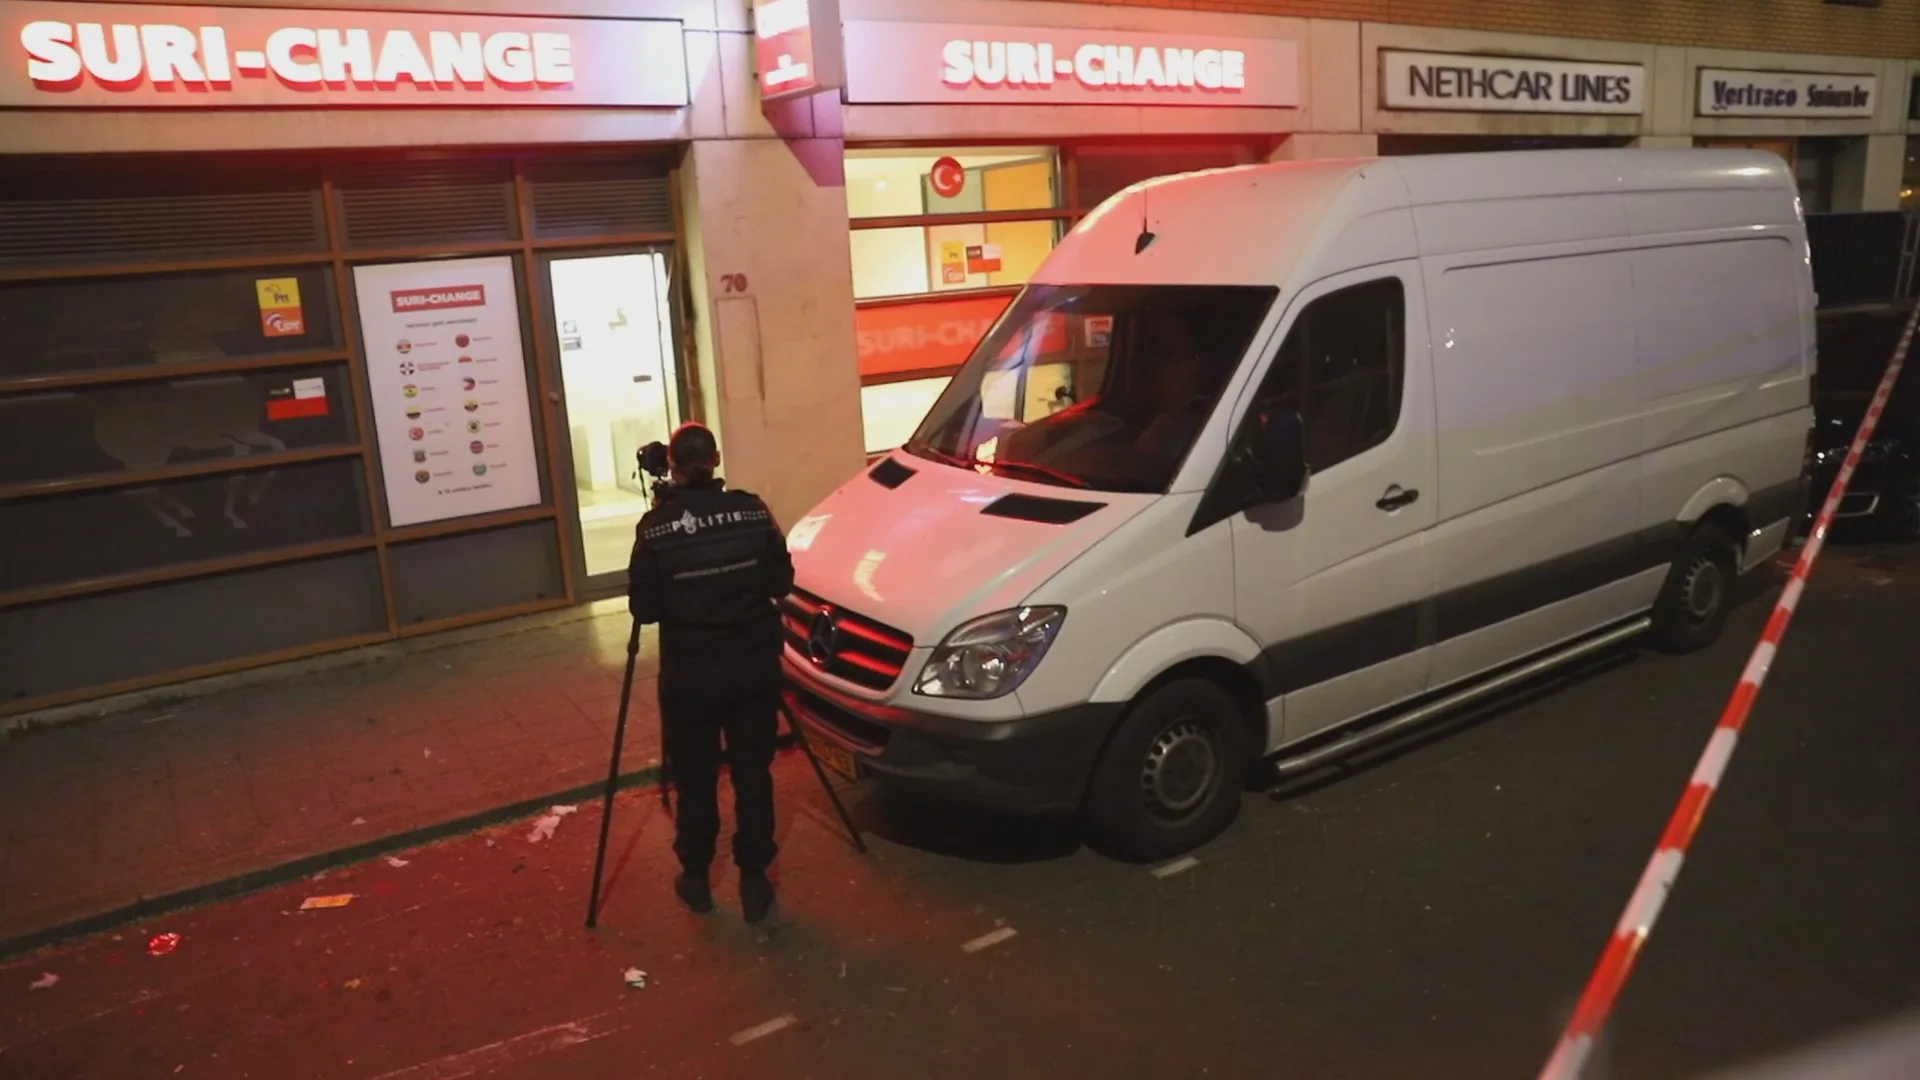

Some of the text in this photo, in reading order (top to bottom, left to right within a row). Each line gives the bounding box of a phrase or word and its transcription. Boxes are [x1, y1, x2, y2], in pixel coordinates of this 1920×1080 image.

[20, 20, 575, 91] SURI-CHANGE
[942, 39, 1246, 92] SURI-CHANGE
[1408, 65, 1632, 104] NETHCAR LINES
[1712, 79, 1798, 108] Vertraco
[395, 290, 482, 307] SURI-CHANGE
[720, 272, 748, 293] 70
